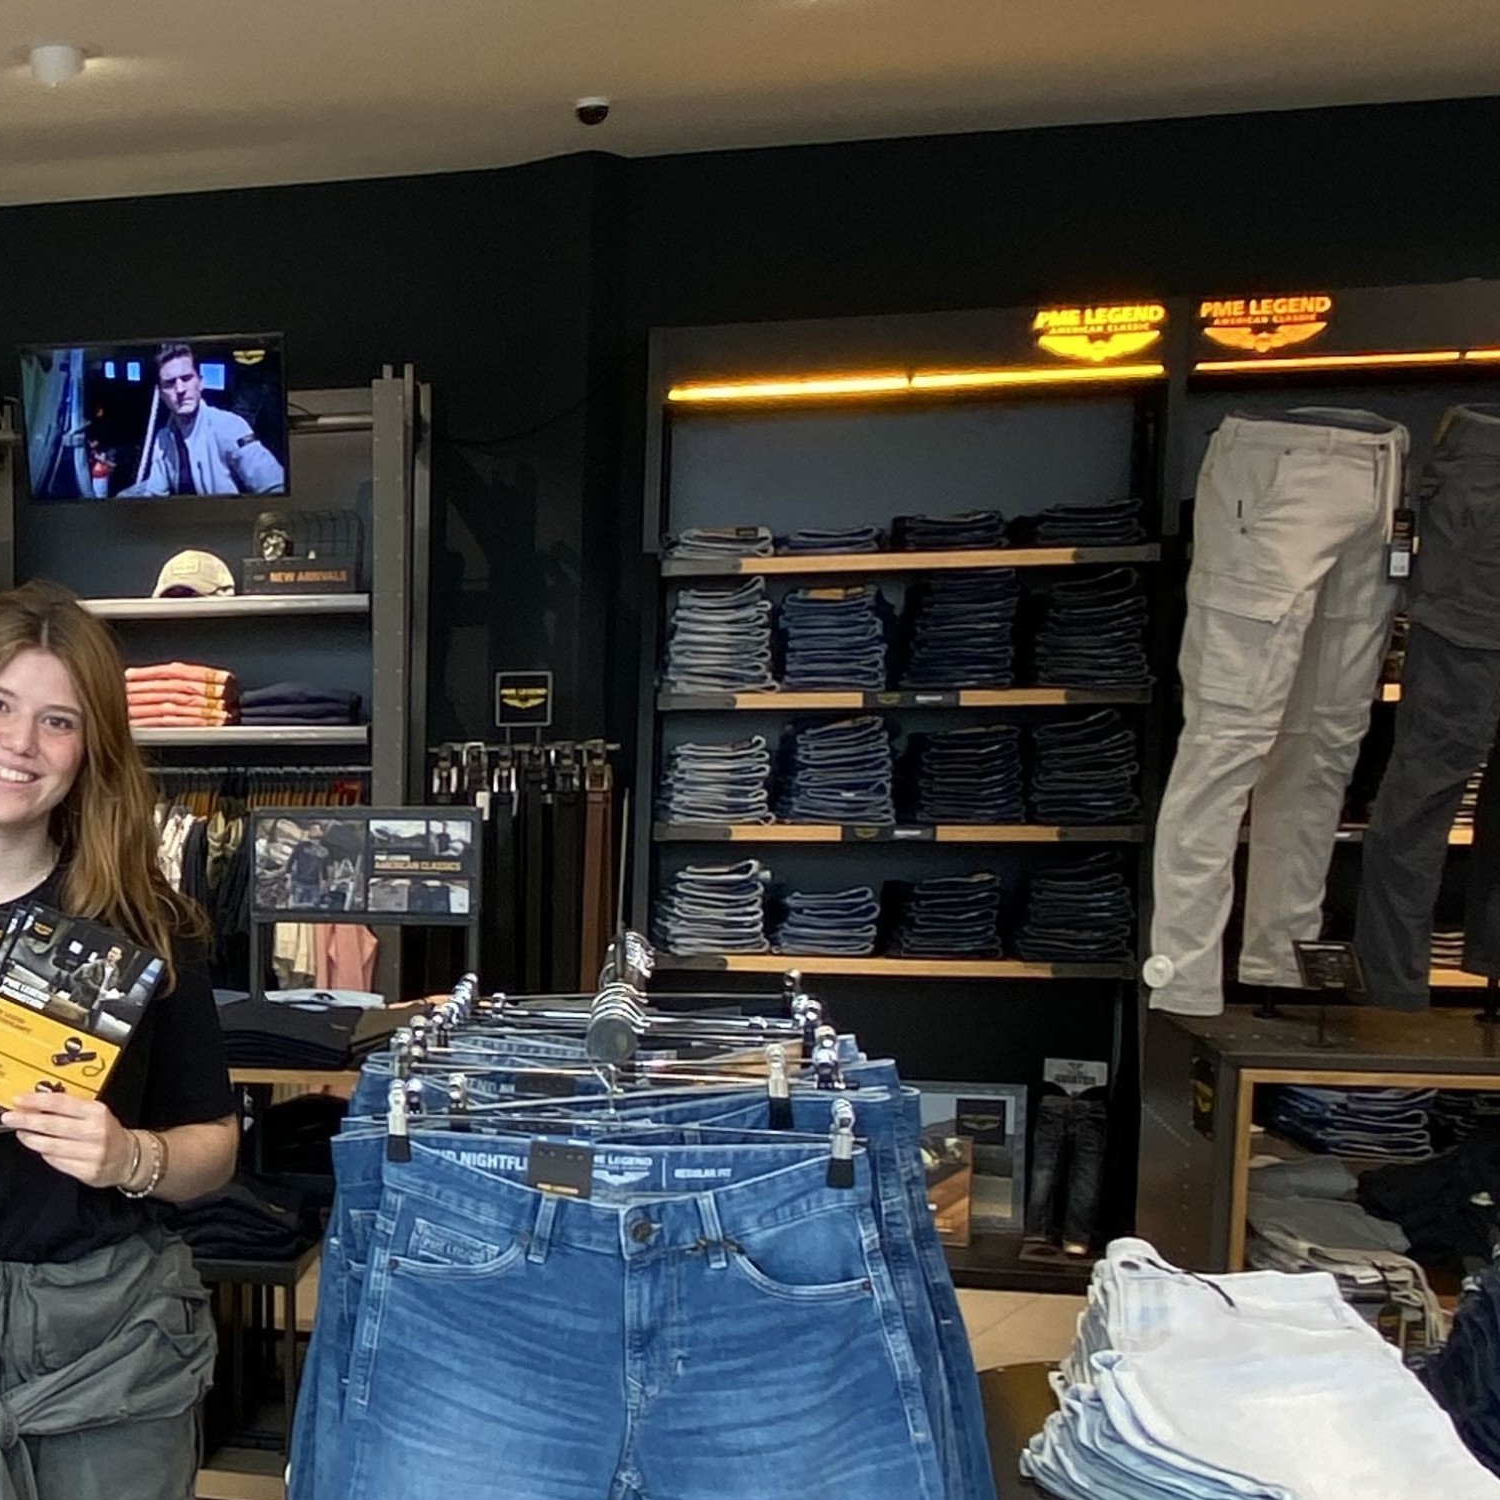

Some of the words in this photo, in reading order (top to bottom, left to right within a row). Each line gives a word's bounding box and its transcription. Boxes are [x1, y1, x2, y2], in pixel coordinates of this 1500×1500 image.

[1200, 301, 1245, 318] PME
[1249, 296, 1331, 315] LEGEND
[1033, 309, 1081, 329] PME
[1085, 305, 1165, 324] LEGEND
[1213, 316, 1269, 326] AMERICAN
[1049, 324, 1104, 334] AMERICAN
[269, 571, 296, 583] NEW
[297, 570, 347, 582] ARRIVALS
[460, 1151, 528, 1171] NIGHTFLI
[608, 1153, 652, 1166] LEGEND
